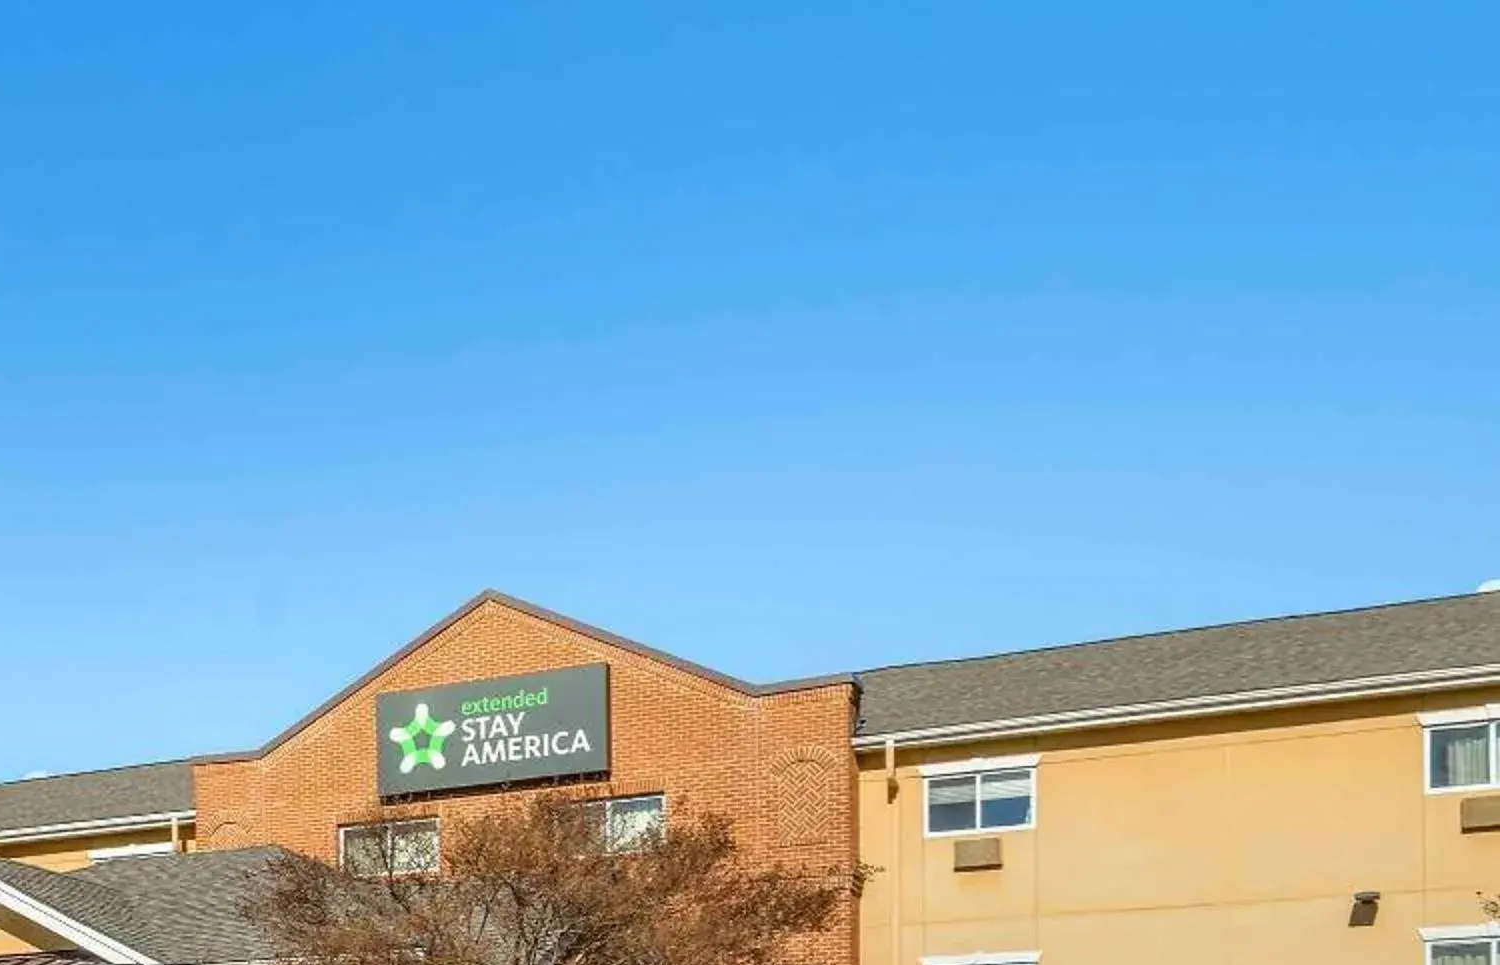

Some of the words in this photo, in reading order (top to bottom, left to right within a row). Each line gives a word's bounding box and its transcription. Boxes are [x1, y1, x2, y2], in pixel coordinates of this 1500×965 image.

[461, 688, 547, 715] extended
[461, 711, 525, 741] STAY
[461, 729, 591, 767] AMERICA
